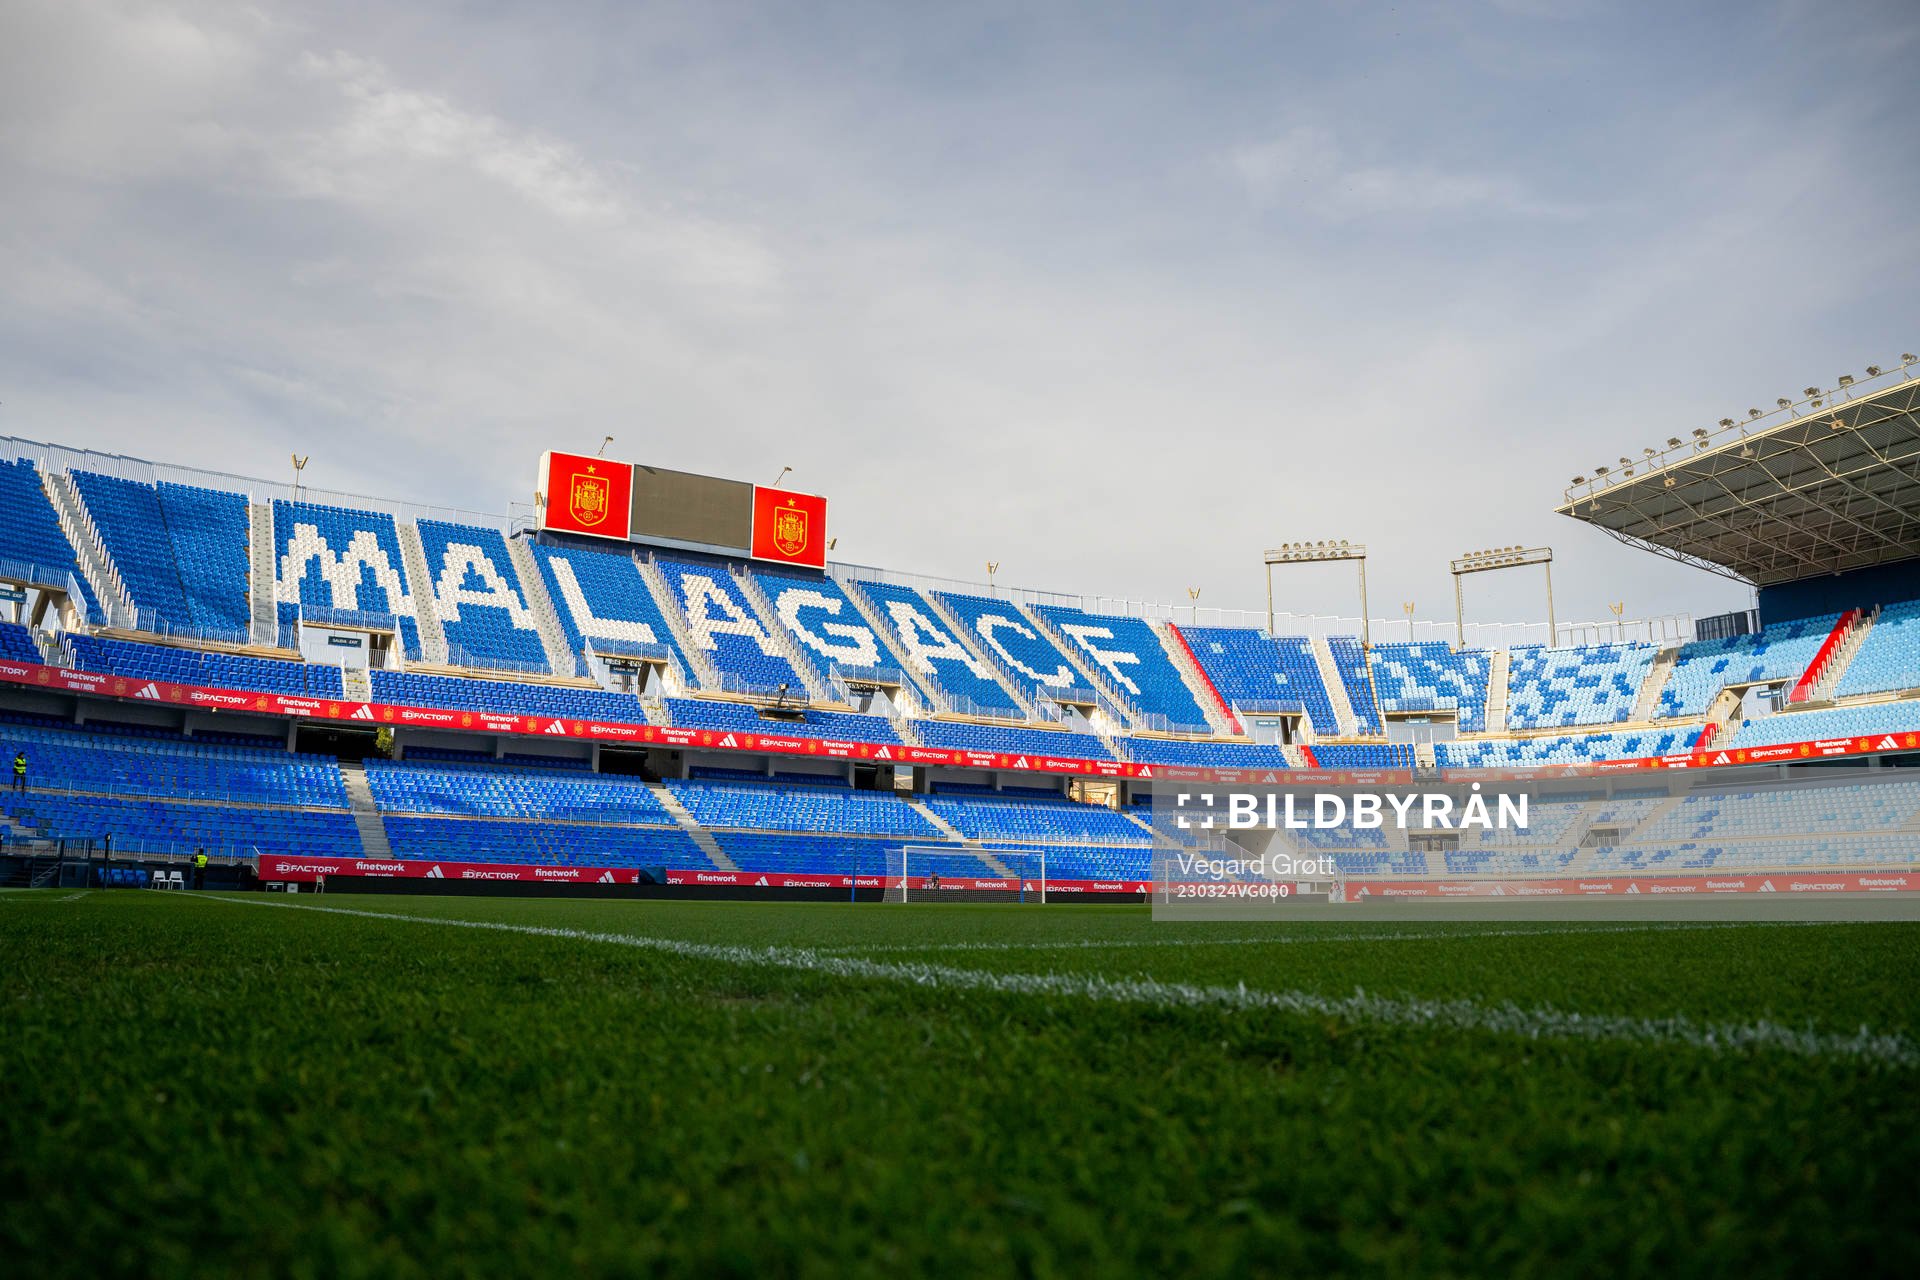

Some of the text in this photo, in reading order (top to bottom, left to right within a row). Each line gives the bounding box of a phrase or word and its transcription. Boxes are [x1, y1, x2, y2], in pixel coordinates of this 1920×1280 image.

[60, 670, 106, 683] finetwork
[277, 697, 320, 708] finetwork
[480, 714, 519, 723] finetwork
[661, 728, 696, 737] finetwork
[823, 741, 855, 749] finetwork
[1815, 739, 1852, 748] finetwork
[967, 754, 996, 762] finetwork
[356, 861, 405, 872] finetwork
[535, 868, 579, 878] finetwork
[697, 873, 736, 882] finetwork
[1706, 880, 1745, 888] finetwork
[1859, 878, 1907, 887] finetwork
